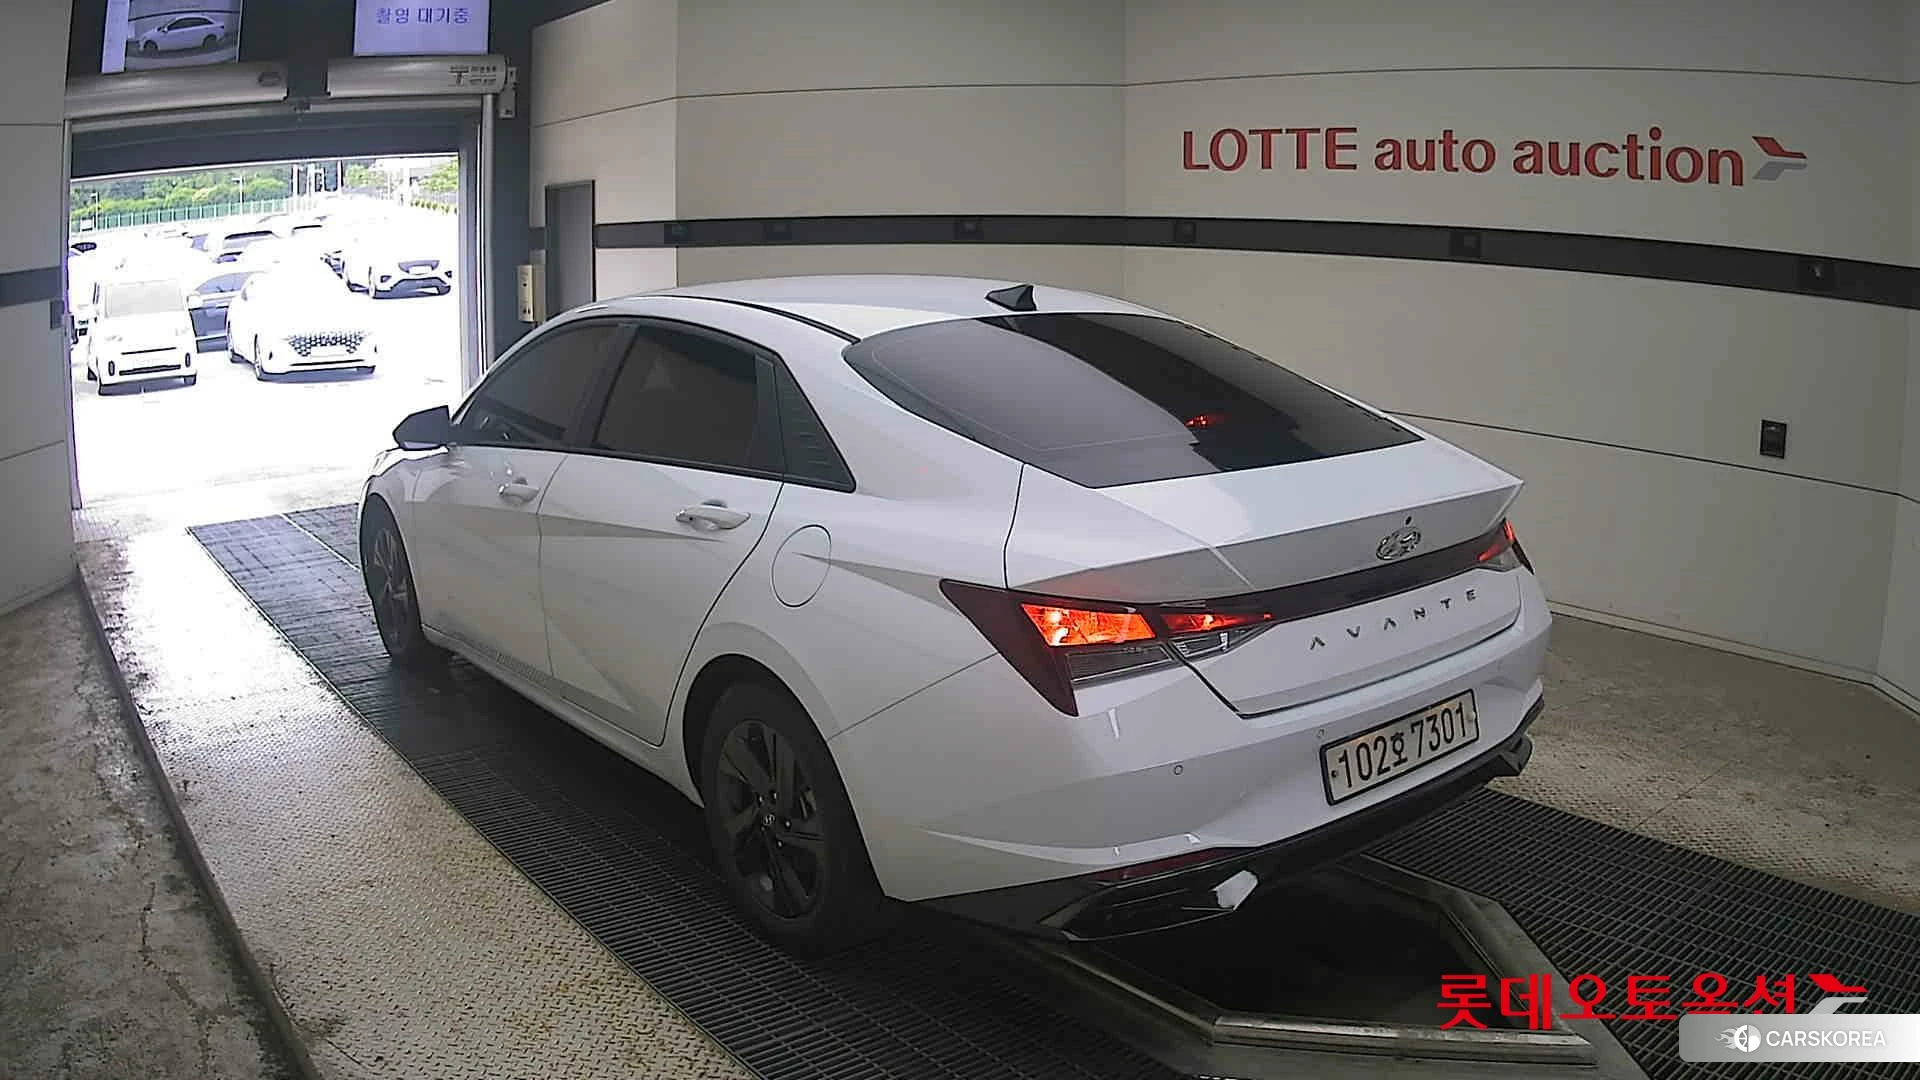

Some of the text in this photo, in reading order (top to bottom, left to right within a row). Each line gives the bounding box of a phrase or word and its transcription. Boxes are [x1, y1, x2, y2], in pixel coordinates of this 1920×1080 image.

[417, 7, 471, 25] 대기중
[1183, 126, 1744, 187] LOTTE auto auction
[1309, 588, 1478, 650] AVANTE
[1410, 701, 1467, 758] 7301
